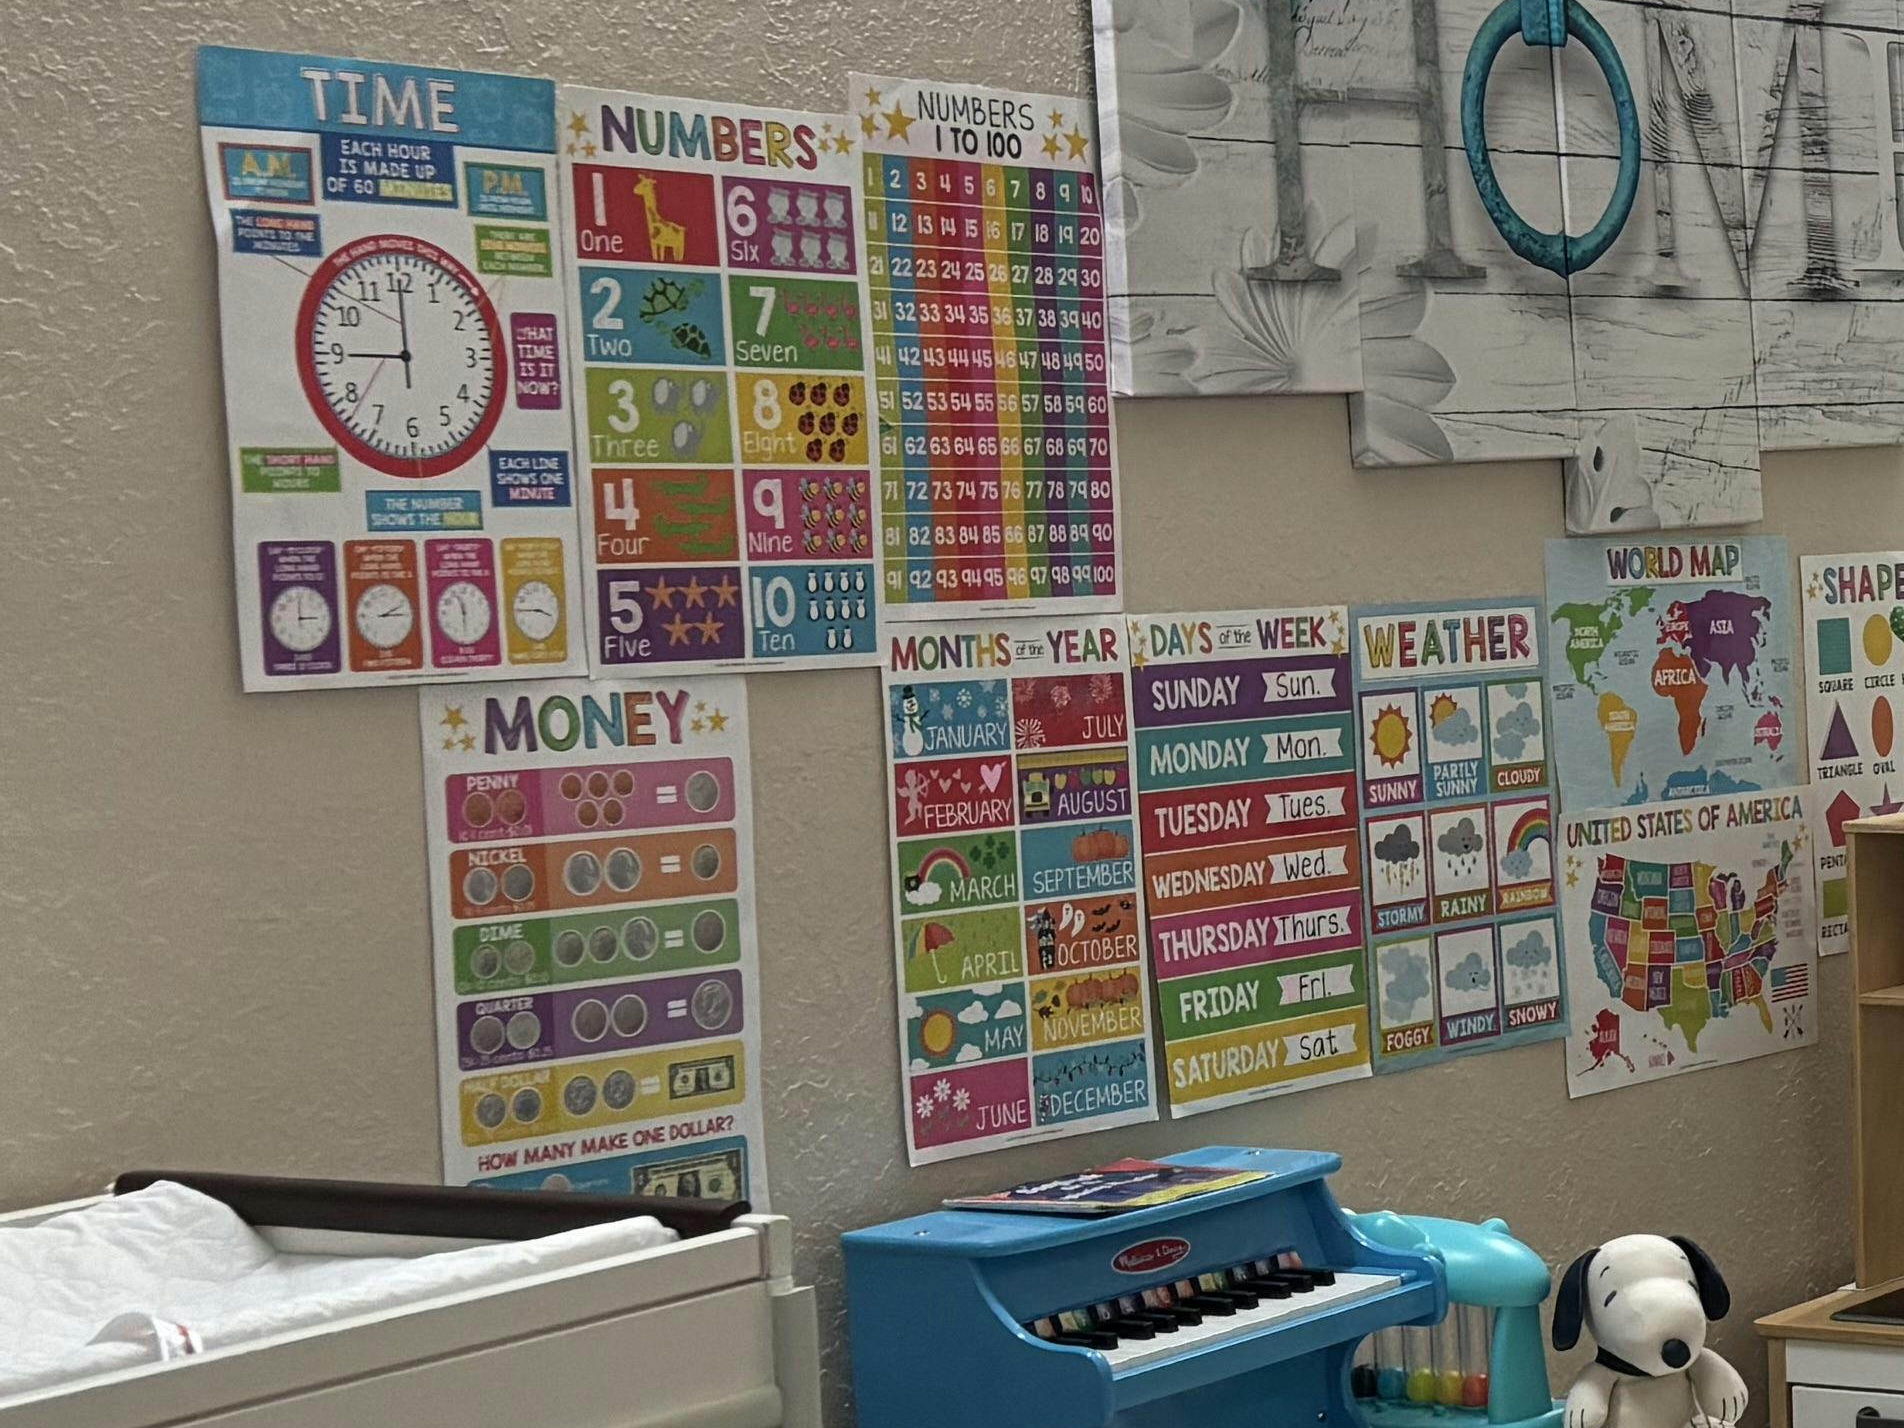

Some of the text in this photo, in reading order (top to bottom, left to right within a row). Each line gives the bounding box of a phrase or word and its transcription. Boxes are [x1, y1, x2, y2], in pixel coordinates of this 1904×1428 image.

[301, 68, 460, 132] TIME
[918, 91, 1034, 130] NUMBERS
[601, 104, 818, 170] NUMBERS
[951, 129, 978, 155] TO
[987, 132, 1022, 159] 100
[341, 140, 431, 160] EACH HOUR
[339, 159, 436, 179] IS MADE UP
[327, 177, 345, 193] OF
[354, 180, 374, 194] 60
[592, 173, 607, 226] 1
[727, 186, 757, 237] 6
[581, 230, 623, 253] One
[732, 240, 759, 262] Six
[359, 282, 380, 301] 11
[387, 273, 413, 293] 12
[430, 284, 440, 303] 1
[591, 277, 623, 330] 2
[750, 286, 776, 337] 7
[337, 306, 360, 326] 10
[454, 311, 465, 330] 2
[332, 344, 344, 364] 9
[517, 345, 554, 360] TIME
[587, 334, 632, 356] Two
[737, 342, 797, 362] Seven
[466, 348, 476, 367] 3
[520, 362, 554, 377] IS IT
[345, 383, 359, 403] 8
[457, 384, 469, 403] 4
[517, 382, 558, 395] NOW?
[372, 405, 384, 424] 7
[440, 406, 450, 426] 5
[608, 380, 639, 433] 3
[754, 380, 782, 430] 8
[407, 417, 418, 437] 6
[592, 435, 659, 458] Three
[743, 432, 798, 460] Eight
[604, 478, 640, 530] 4
[753, 479, 784, 529] 9
[598, 534, 650, 555] Four
[749, 532, 792, 553] Nine
[1607, 546, 1739, 579] WORLD MAP
[609, 581, 643, 633] 5
[752, 576, 795, 628] 10
[1150, 616, 1327, 656] DAYS of the WEEK
[1709, 620, 1734, 635] ASIA
[604, 636, 652, 658] Five
[760, 630, 796, 651] Ten
[891, 628, 1118, 671] MONTHS of the YEAR
[1364, 614, 1530, 668] WEATHER
[1654, 669, 1696, 686] AFRICA
[1819, 679, 1853, 693] SQUARE
[1865, 674, 1895, 689] CIRCLE
[1152, 673, 1320, 711] SUNDAY Sun.
[485, 690, 689, 754] MONEY
[1083, 715, 1124, 739] JULY
[925, 723, 1008, 751] JANUARY
[1151, 734, 1327, 776] MONDAY Mon.
[467, 775, 518, 791] PENNY
[1434, 762, 1478, 781] PARTLY
[1498, 768, 1540, 786] CLOUDY
[1370, 780, 1417, 803] SUNNY
[1436, 780, 1478, 797] SUNNY
[924, 799, 1012, 828] FEBRUARY
[1058, 789, 1127, 816] AUGUST
[1154, 794, 1330, 838] TUESDAY Tues.
[1567, 796, 1802, 848] UNITED STATES OF AMERICA
[469, 848, 527, 866] NICKEL
[1033, 861, 1135, 894] SEPTEMBER
[1153, 850, 1331, 899] WEDNESDAY Wed.
[951, 875, 1015, 902] MARCH
[1503, 888, 1549, 904] RAINBOW
[1378, 905, 1424, 928] STORMY
[1440, 895, 1486, 917] RAINY
[480, 924, 523, 941] DIME
[1159, 913, 1344, 962] THURSDAY Thurs.
[1058, 934, 1137, 965] OCTOBER
[962, 950, 1020, 980] APRIL
[476, 998, 533, 1015] QUARTER
[1179, 981, 1259, 1022] FRIDAY
[1043, 1007, 1141, 1041] NOVEMBER
[1509, 1002, 1556, 1026] SNOWY
[1447, 1014, 1494, 1039] WINDY
[985, 1026, 1024, 1052] MAY
[1387, 1027, 1430, 1051] FOGGY
[1173, 1039, 1279, 1088] SATURDAY
[1050, 1079, 1146, 1116] DECEMBER
[977, 1099, 1027, 1129] JUNE
[478, 1116, 734, 1171] HOW MANY MAKE ONE DOLLAR?
